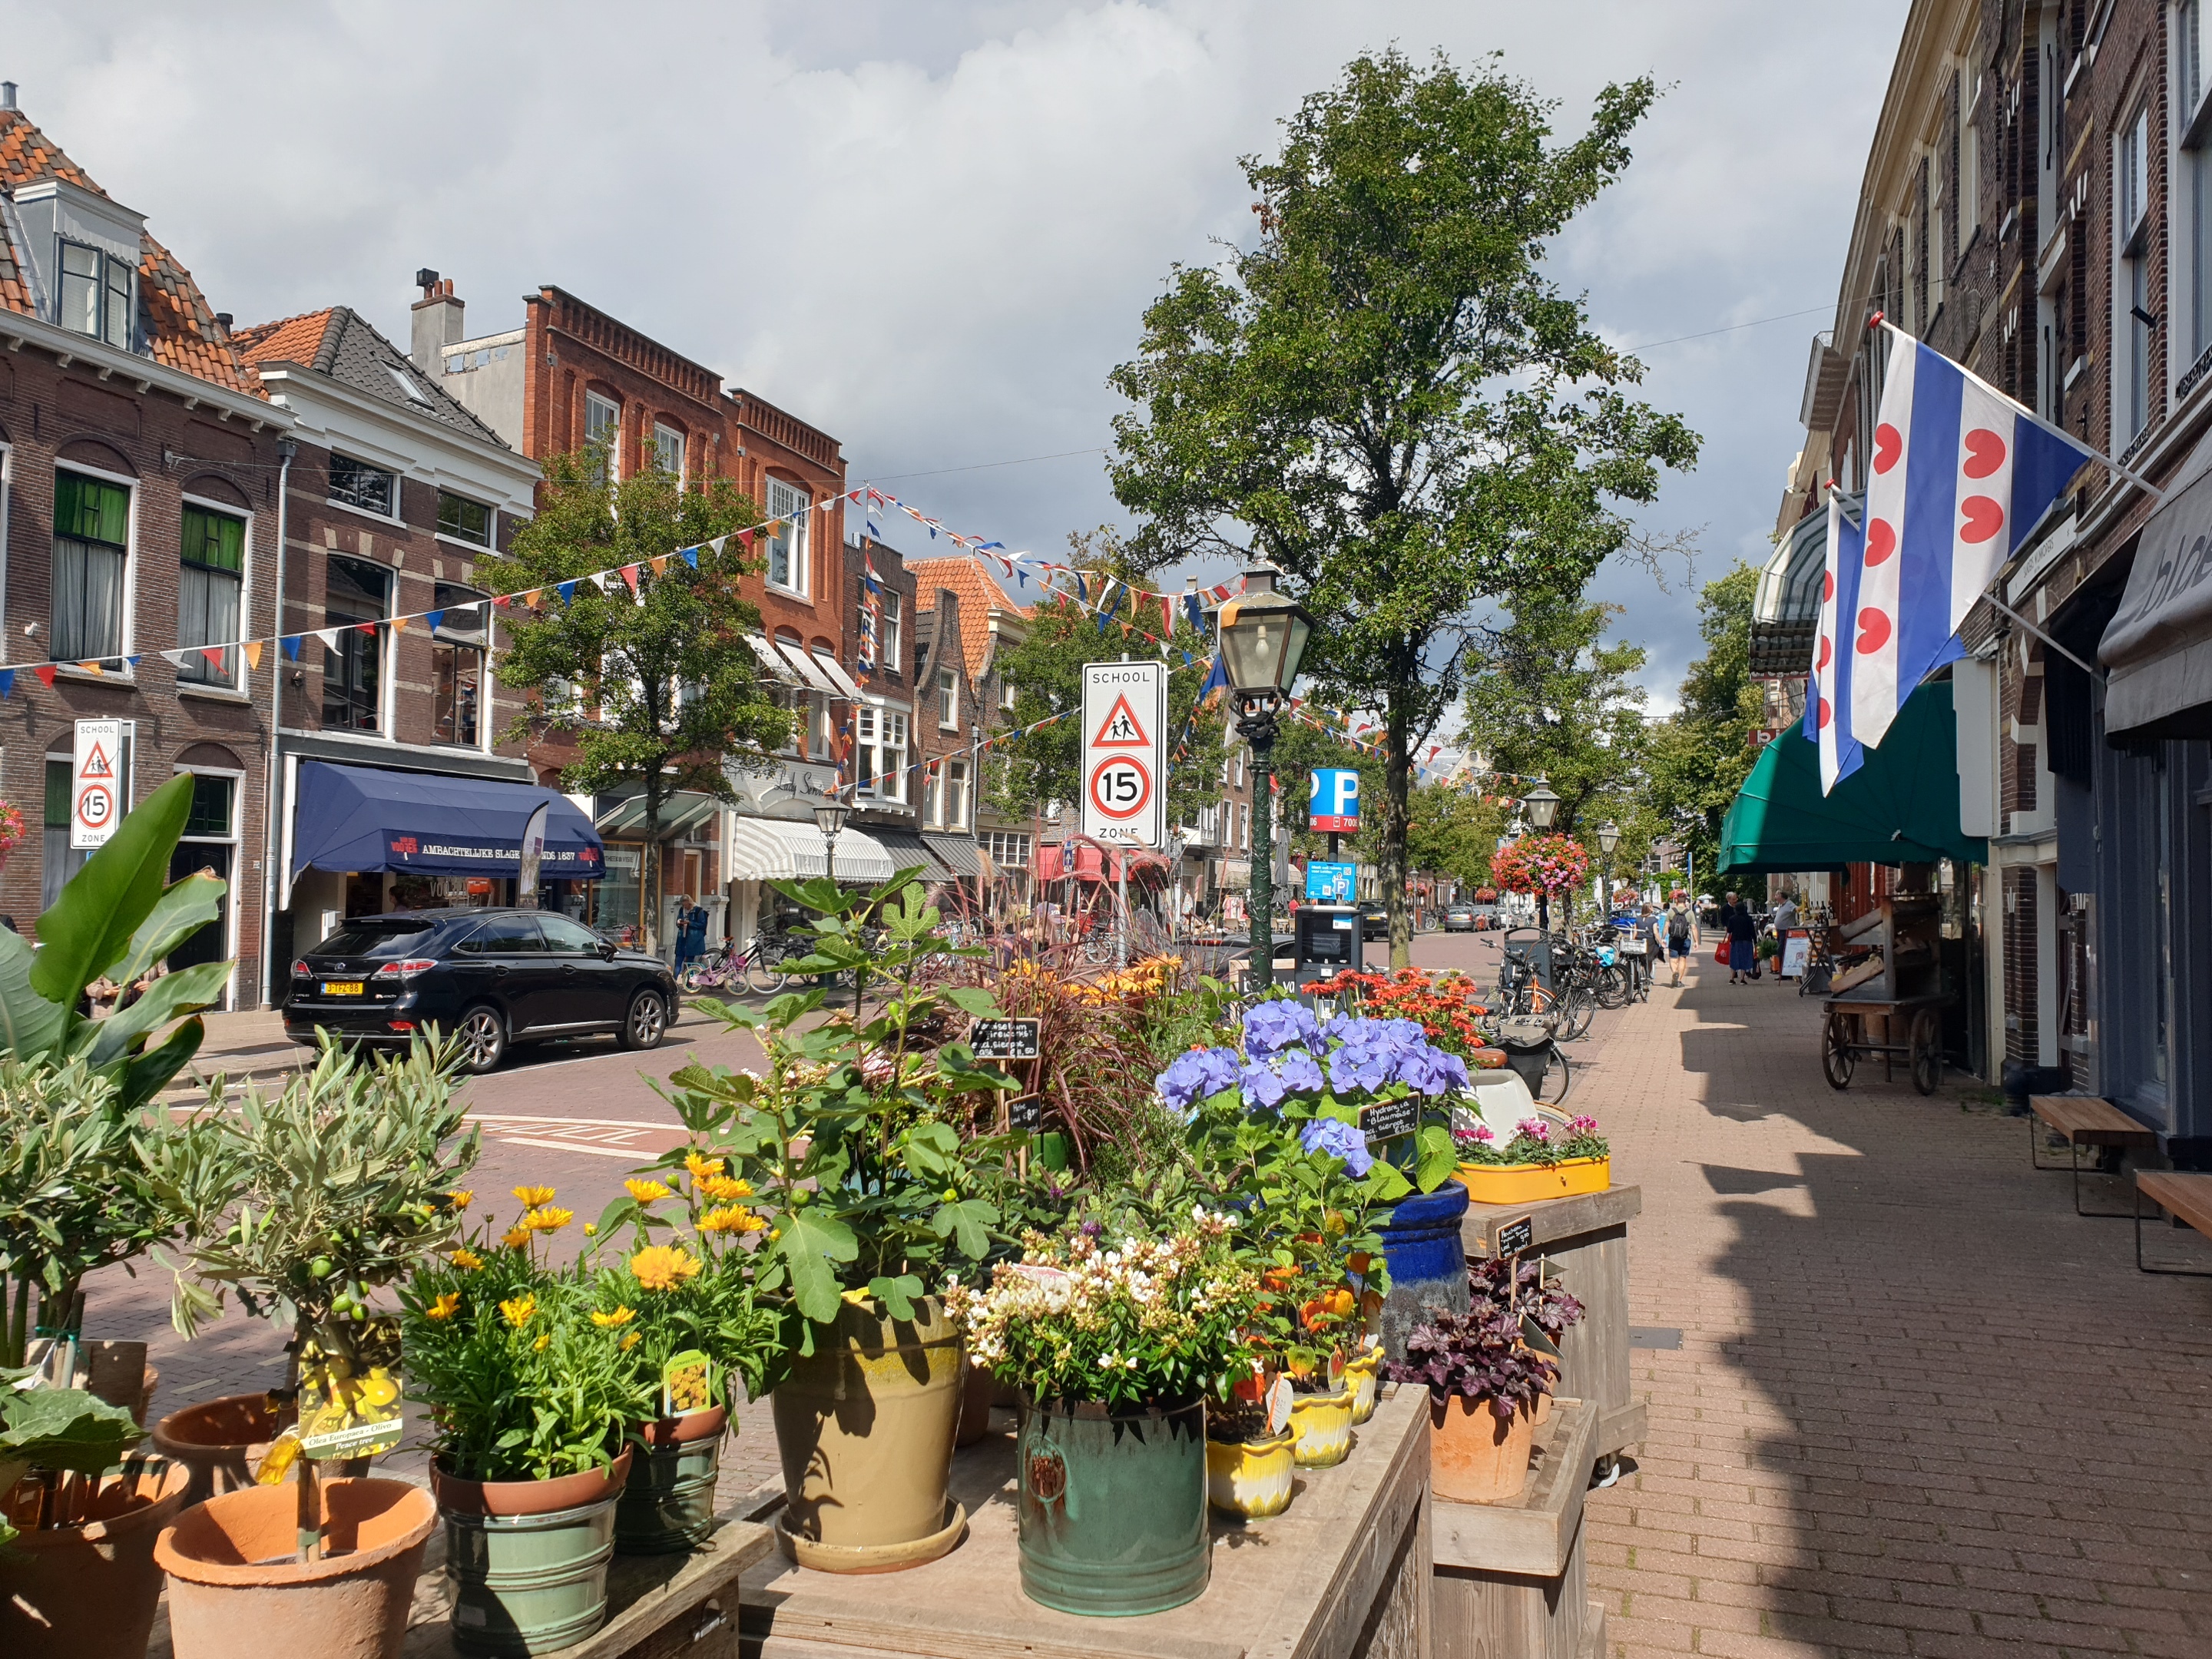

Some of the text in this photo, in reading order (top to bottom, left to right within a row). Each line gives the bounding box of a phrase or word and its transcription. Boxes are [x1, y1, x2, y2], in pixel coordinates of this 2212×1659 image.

[1092, 671, 1150, 684] SCHOOL
[773, 770, 797, 799] Lady
[1103, 772, 1137, 801] 15
[1334, 771, 1359, 814] P
[84, 796, 105, 816] 15
[422, 844, 494, 859] AMBACHTELIJKE
[495, 849, 521, 859] SLAGE
[557, 850, 575, 861] 1837
[327, 983, 359, 992] 3-TFZ-88
[309, 1438, 327, 1446] Olea
[329, 1429, 364, 1444] Europaea
[371, 1422, 392, 1432] Olivo
[335, 1436, 375, 1451] Peace tree
